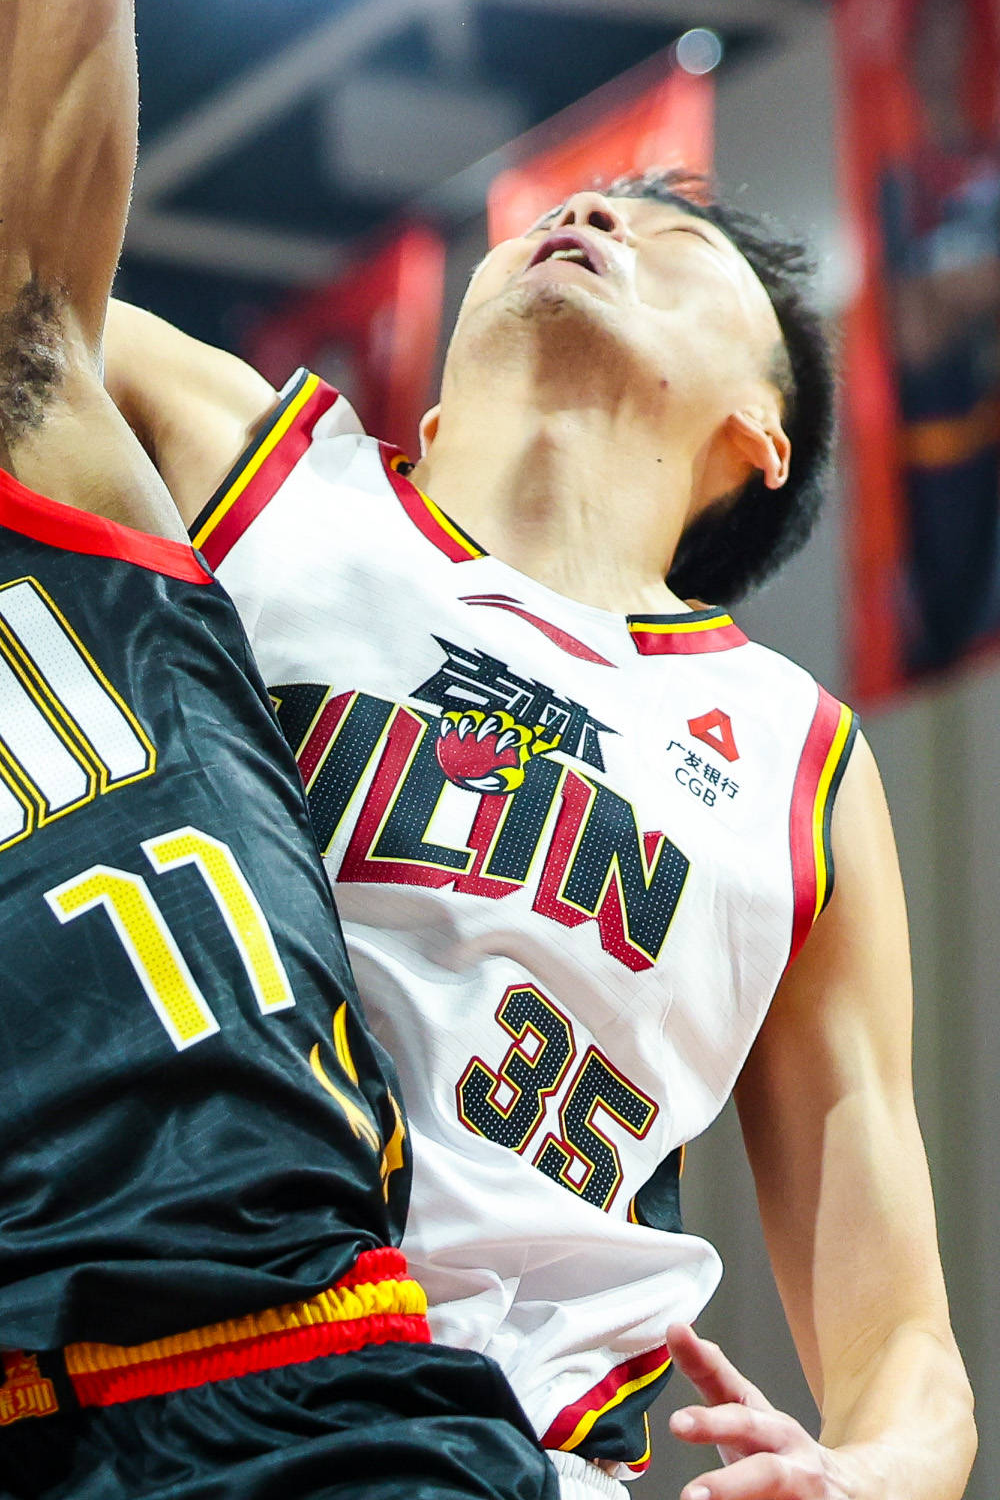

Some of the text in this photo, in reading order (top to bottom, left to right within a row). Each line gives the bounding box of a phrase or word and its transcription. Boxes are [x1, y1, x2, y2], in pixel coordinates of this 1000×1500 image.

[666, 740, 740, 799] 广发银行
[675, 767, 717, 807] CGB
[456, 982, 659, 1212] 35
